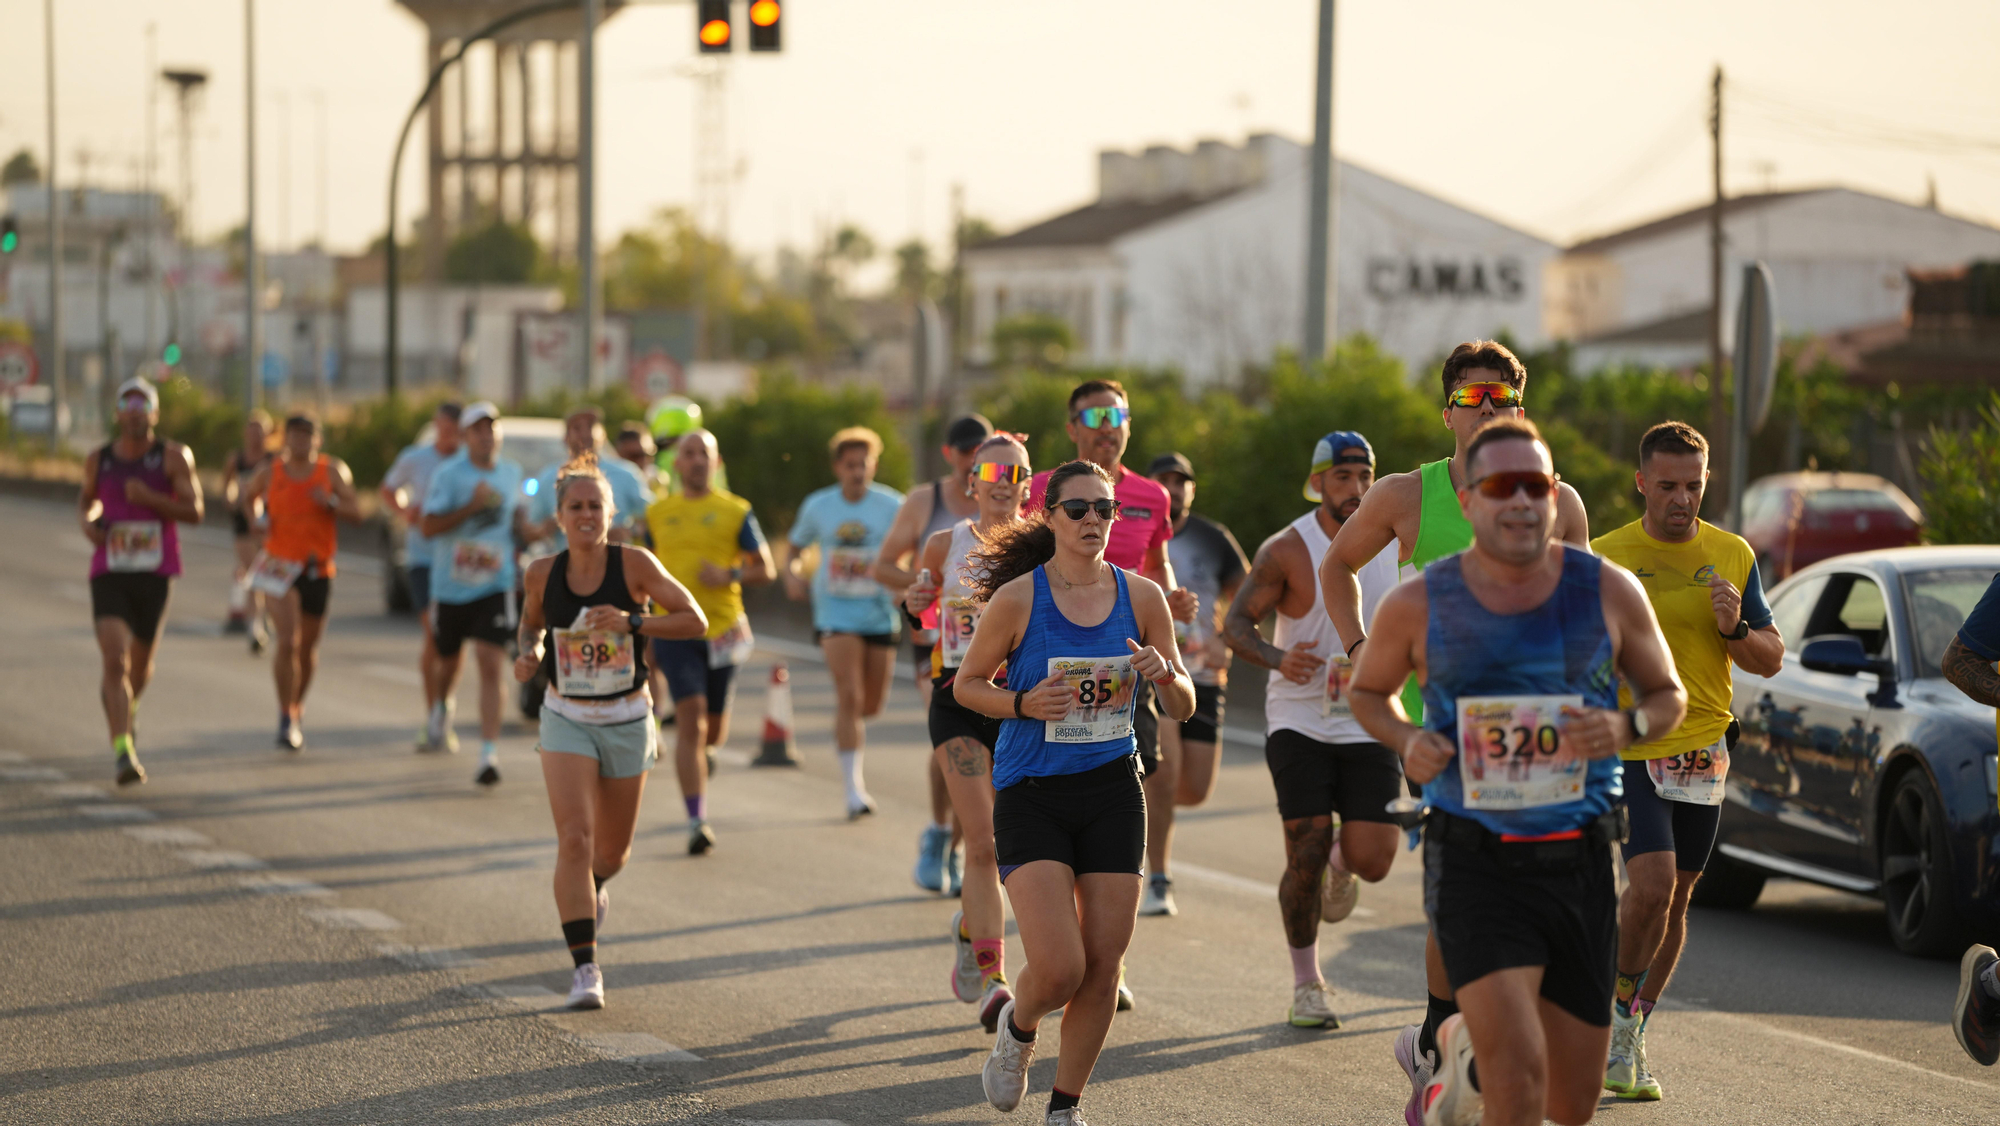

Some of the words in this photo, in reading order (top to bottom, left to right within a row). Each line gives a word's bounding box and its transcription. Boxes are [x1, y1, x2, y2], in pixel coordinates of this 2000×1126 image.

[1366, 256, 1525, 302] CAMAS
[961, 614, 981, 636] 3
[581, 643, 610, 664] 98
[1079, 679, 1112, 704] 85
[1488, 724, 1559, 759] 320
[1667, 749, 1712, 770] 393
